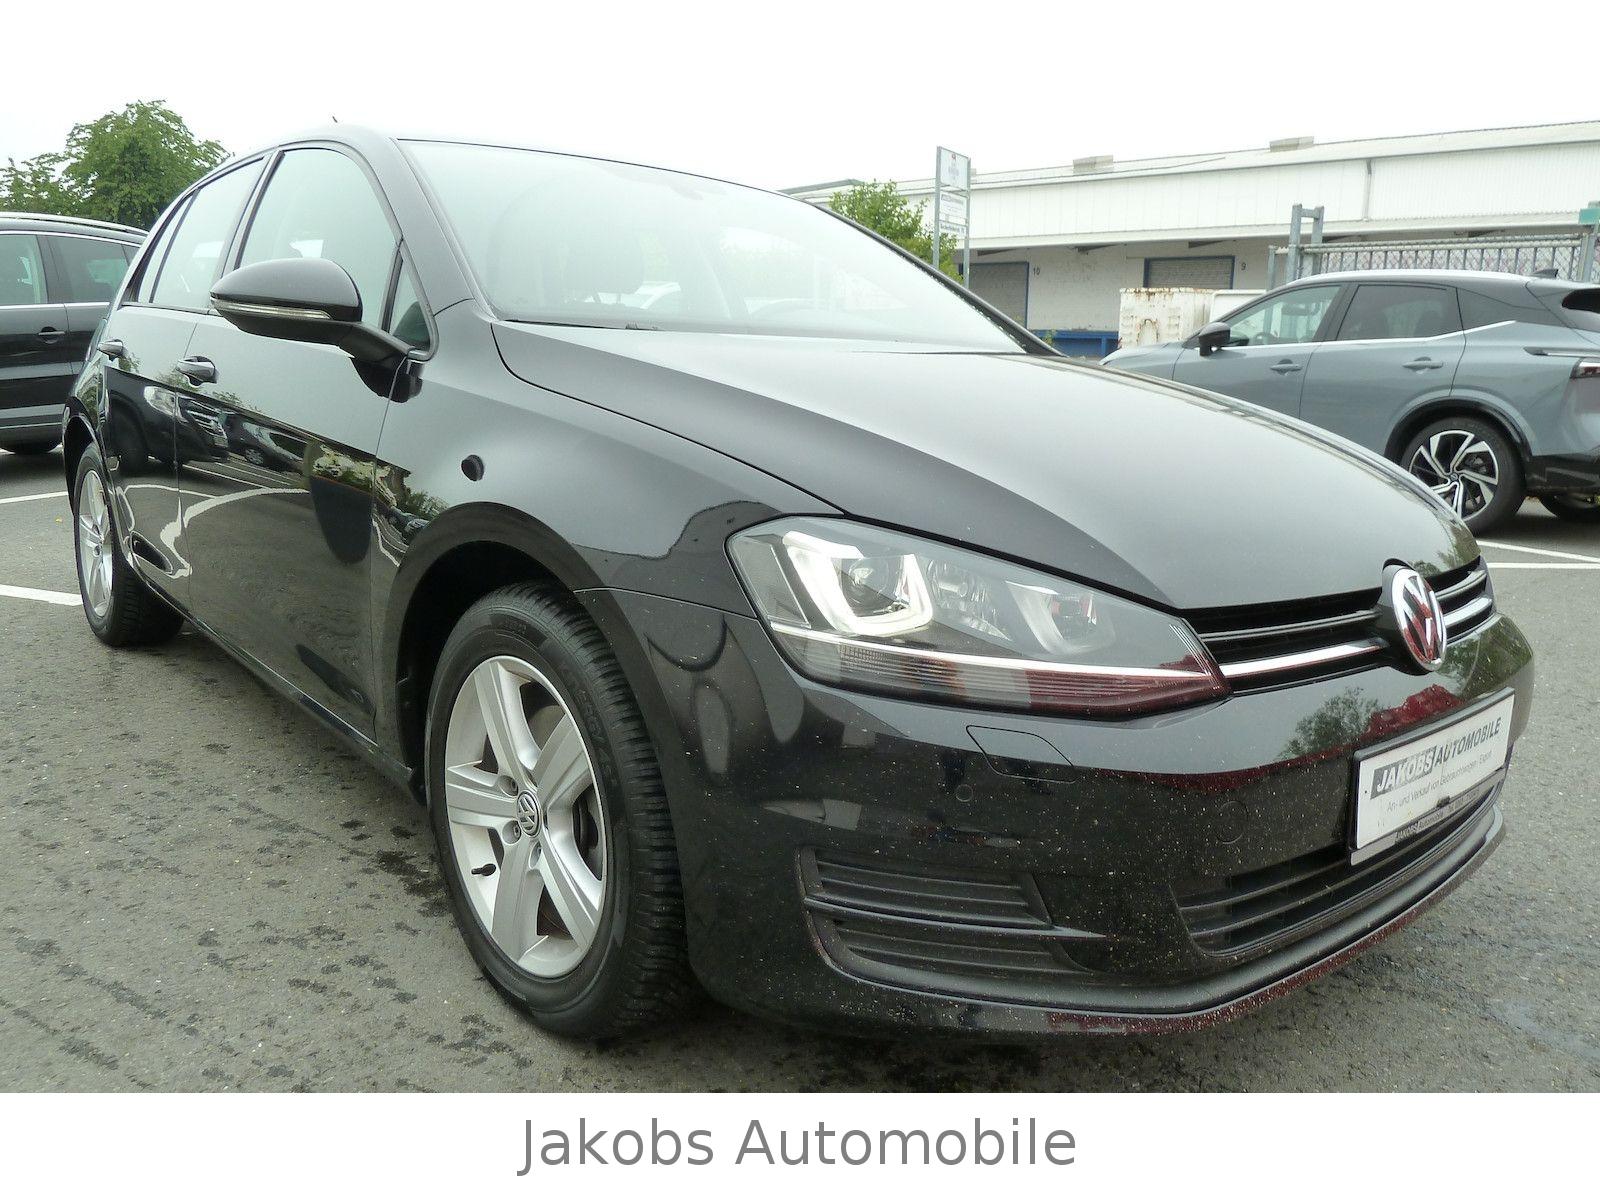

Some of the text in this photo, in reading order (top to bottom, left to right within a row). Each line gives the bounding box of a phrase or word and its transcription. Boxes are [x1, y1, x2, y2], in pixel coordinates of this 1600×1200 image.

[1032, 266, 1041, 276] 10
[1241, 262, 1247, 271] 9
[1377, 717, 1502, 793] JAKOBS AUTOMOBILE
